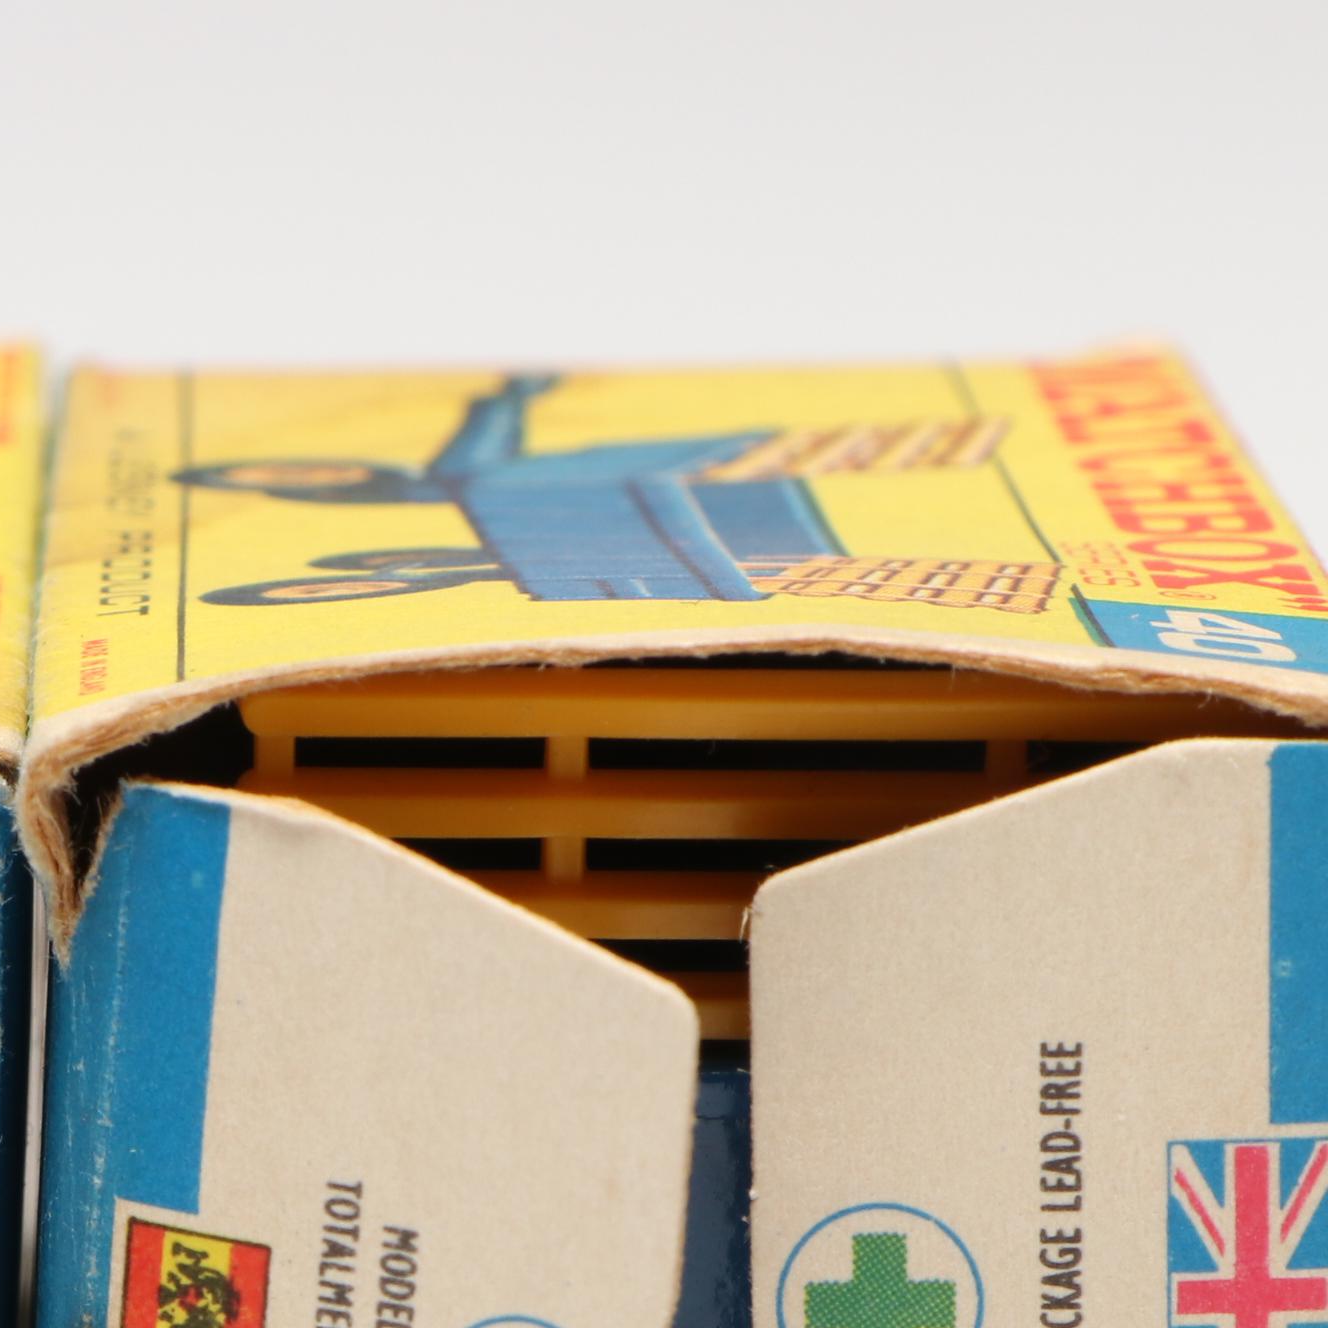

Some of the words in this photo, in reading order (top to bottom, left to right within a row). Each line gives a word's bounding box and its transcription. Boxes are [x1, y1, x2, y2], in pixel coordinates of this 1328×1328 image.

[96, 530, 152, 617] PRODUCT
[81, 638, 109, 658] MADE
[1149, 608, 1297, 662] 40
[1039, 1041, 1083, 1213] LEAD-FREE
